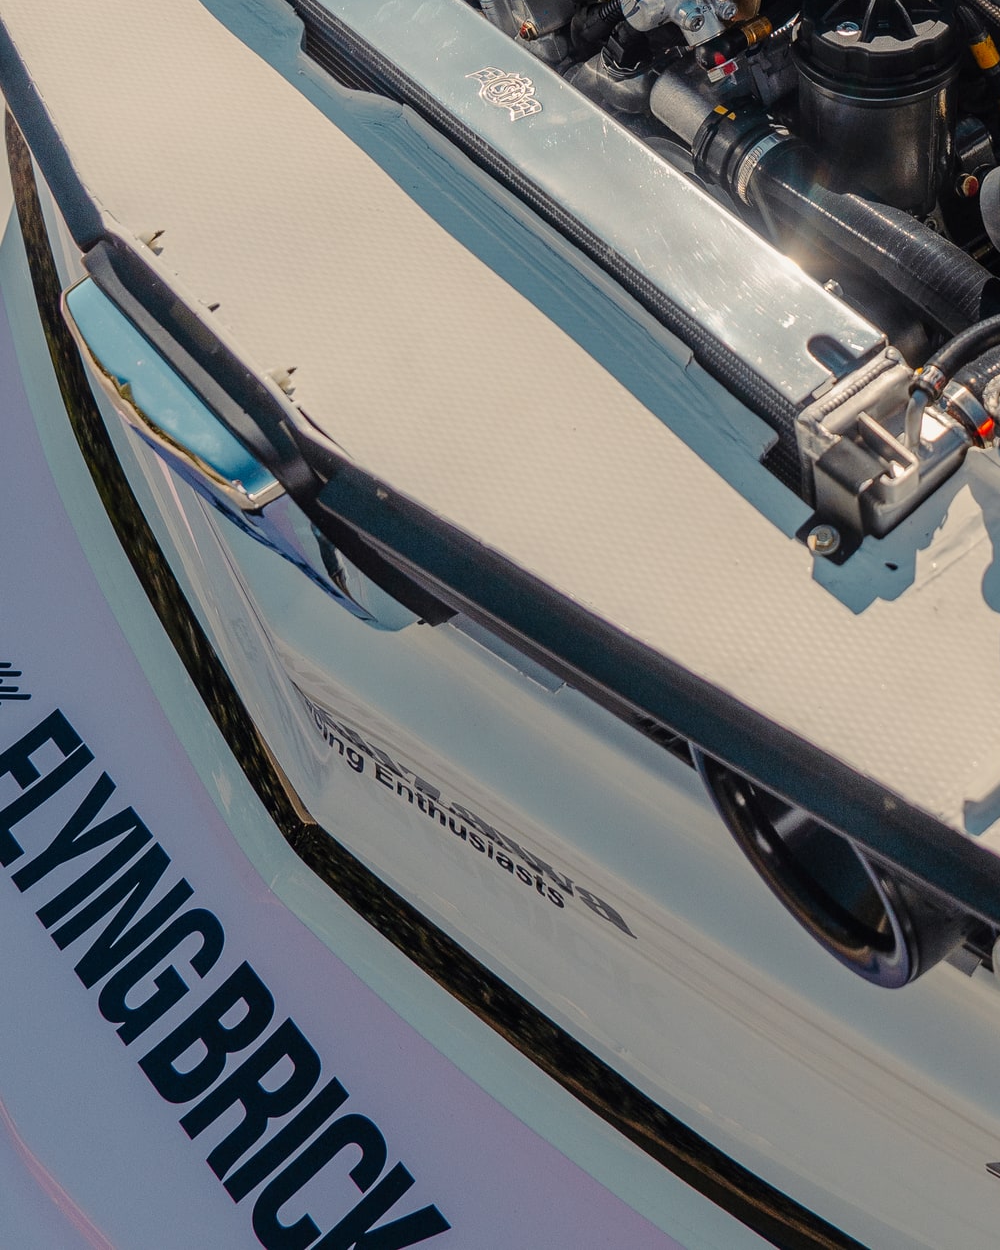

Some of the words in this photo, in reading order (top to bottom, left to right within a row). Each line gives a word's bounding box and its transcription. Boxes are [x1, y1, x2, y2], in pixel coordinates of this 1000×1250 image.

[0, 708, 225, 1046] FLYING
[137, 960, 452, 1250] BRICK
[374, 761, 565, 909] Enthusiasts
